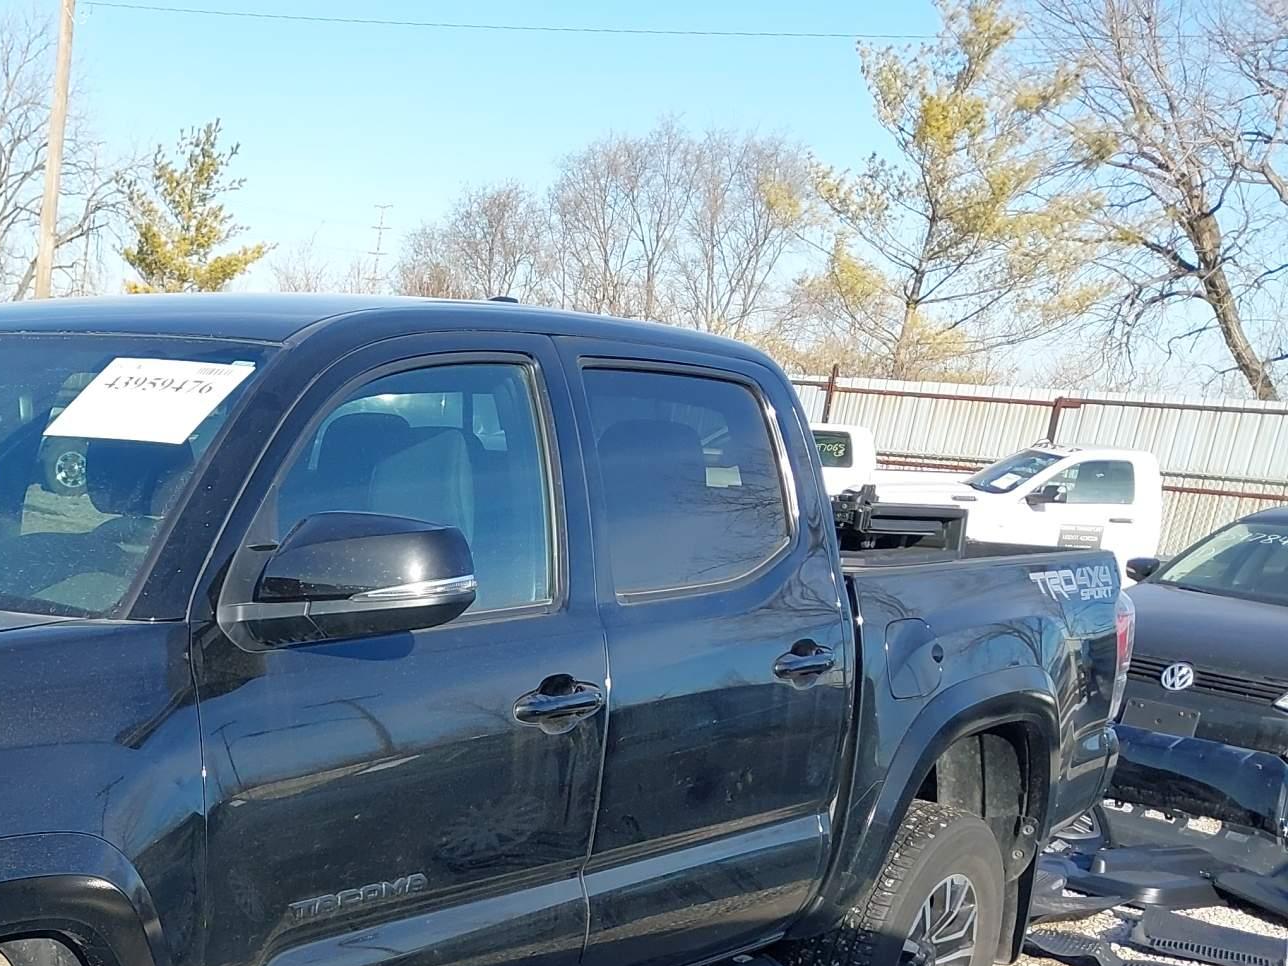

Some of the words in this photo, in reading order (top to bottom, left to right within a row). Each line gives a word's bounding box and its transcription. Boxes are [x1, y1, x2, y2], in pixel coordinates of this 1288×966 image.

[104, 375, 214, 394] 43959476
[1028, 569, 1079, 601] TRD
[1080, 586, 1112, 601] SPORT
[288, 872, 429, 921] TACOMA
